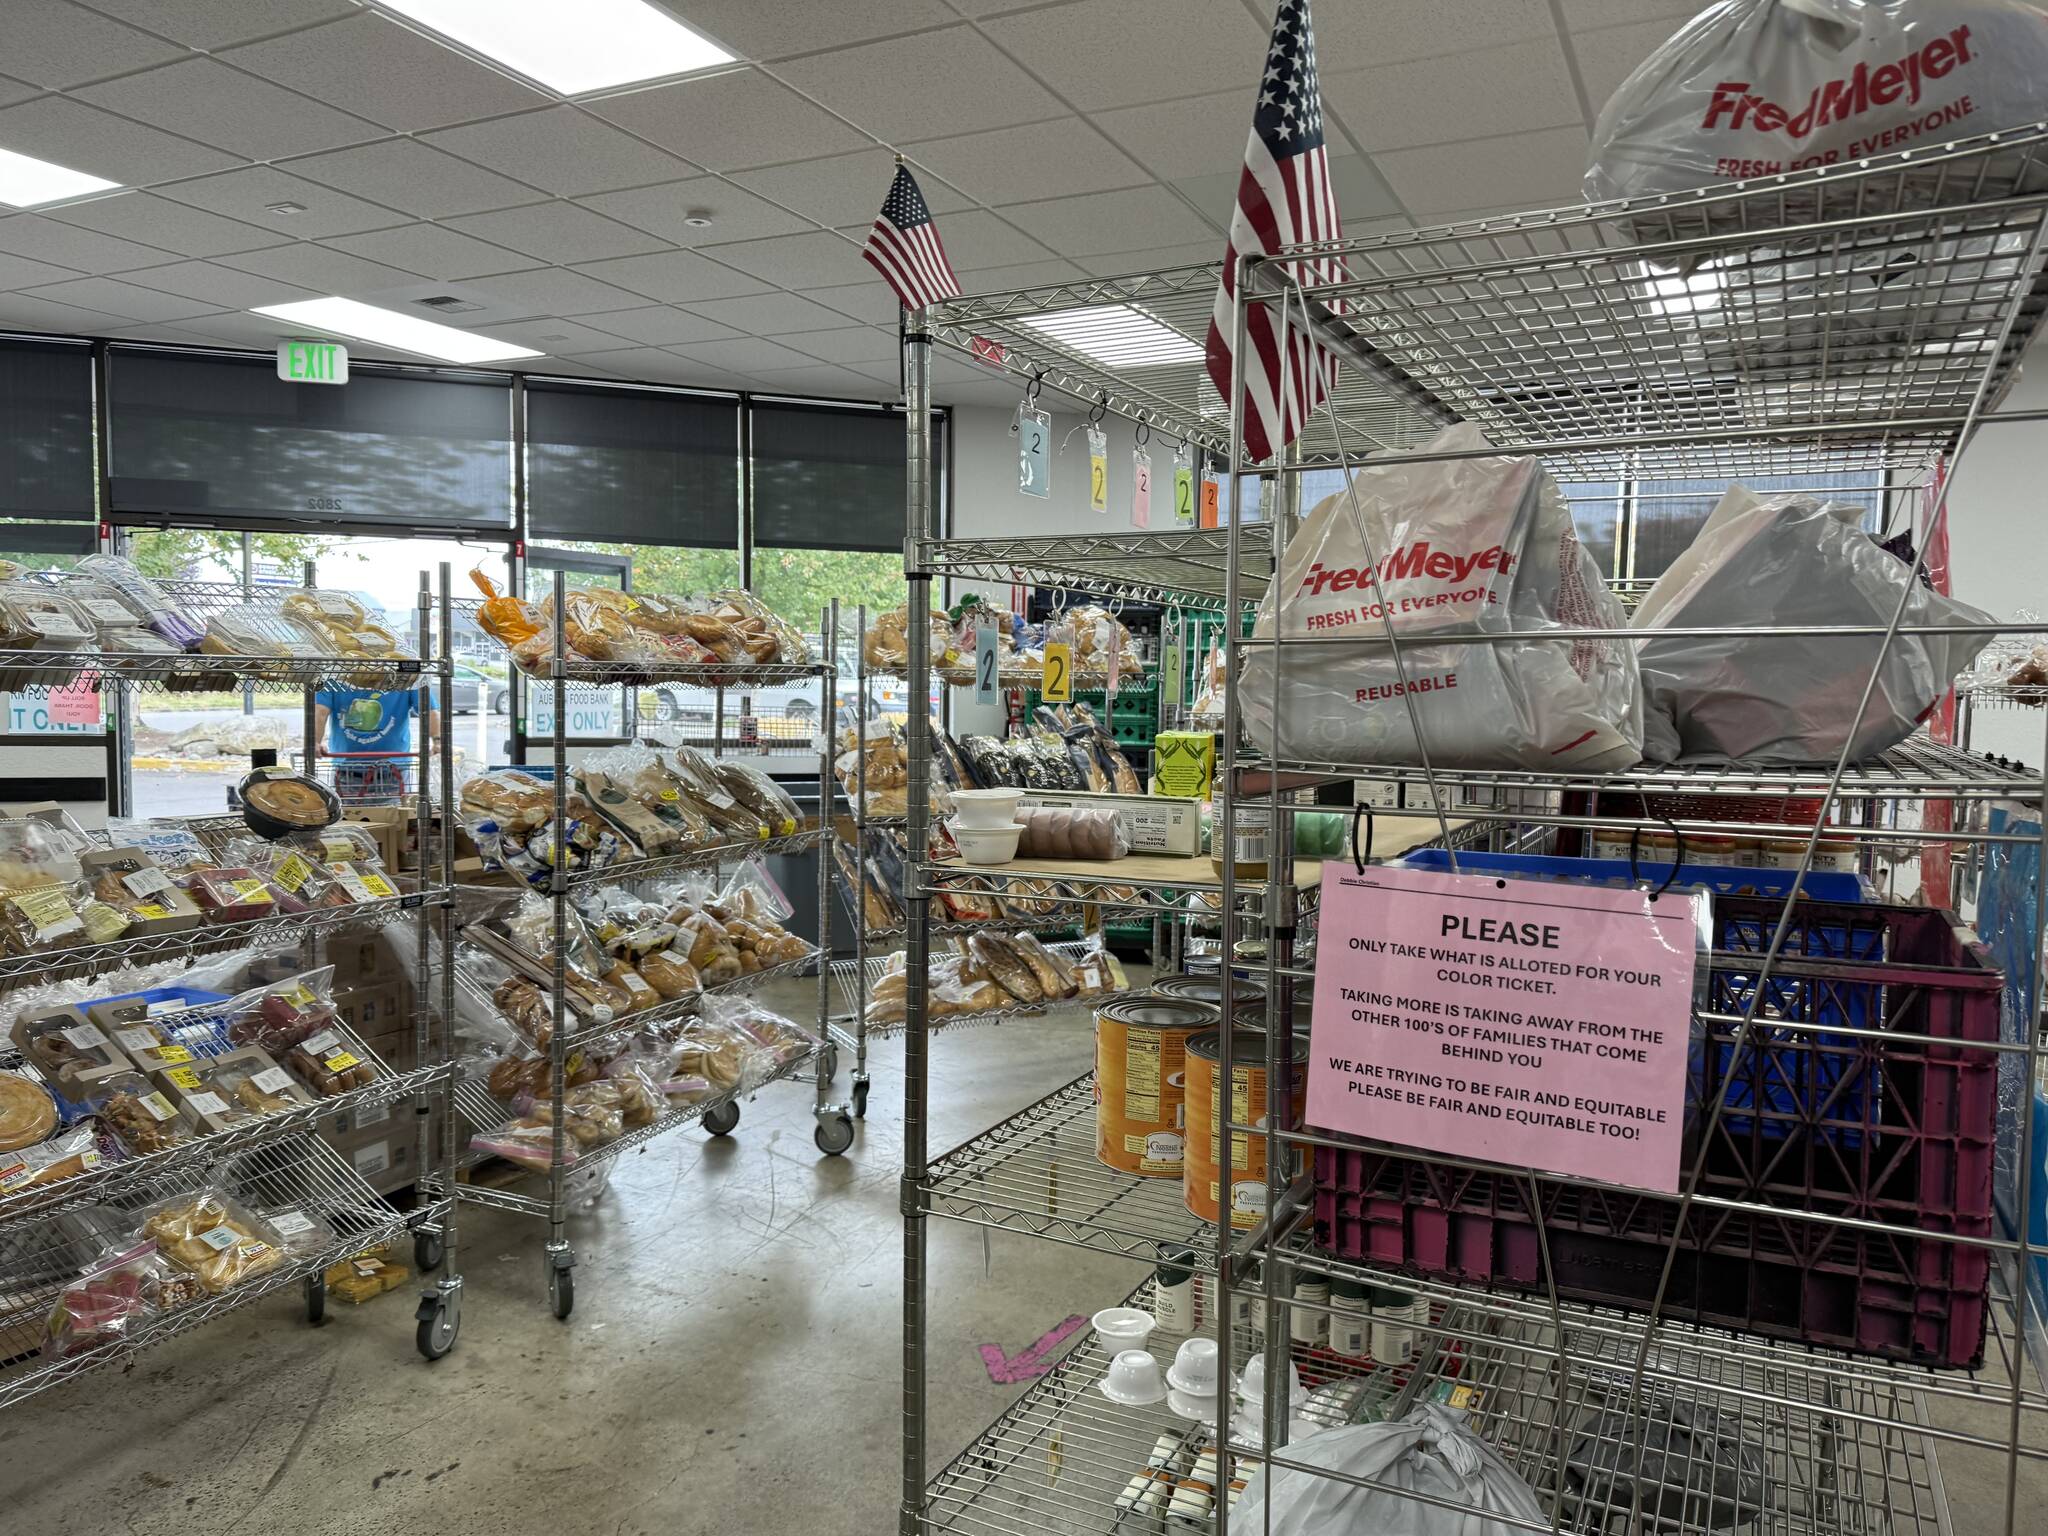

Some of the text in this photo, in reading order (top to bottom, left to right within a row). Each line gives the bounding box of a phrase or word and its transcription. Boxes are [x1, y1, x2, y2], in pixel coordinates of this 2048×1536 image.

[1714, 158, 1781, 178] FRESH
[1791, 150, 1839, 172] FOR
[289, 344, 336, 380] EXIT
[1031, 432, 1041, 455] 2
[1093, 466, 1104, 505] 2
[1140, 473, 1147, 493] 2
[1179, 479, 1191, 514] 2
[1208, 488, 1215, 506] 2
[1307, 608, 1357, 630] FRESH
[1361, 602, 1397, 621] FOR
[981, 649, 994, 691] 2
[1048, 655, 1064, 696] 2
[1171, 654, 1177, 671] 2
[570, 693, 589, 705] FOOD
[590, 693, 609, 705] BANK
[1356, 674, 1457, 702] REUSABLE
[573, 711, 610, 731] ONLY
[1441, 914, 1560, 949] PLEASE
[1349, 937, 1662, 987] ONLY TAKE WHAT IS ALLOTED FOR YOUR
[1437, 969, 1557, 995] COLOR TICKET.
[1340, 988, 1664, 1045] TAKING MORE IS TAKING AWAY FROM THE
[1351, 1009, 1400, 1028] OTHER
[1448, 1024, 1470, 1038] OF
[1473, 1028, 1547, 1049] FAMILIES
[1550, 1037, 1593, 1055] THAT
[1596, 1044, 1648, 1063] COME
[1441, 1043, 1543, 1068] BEHIND YOU
[1329, 1057, 1667, 1124] WE ARE TRYING TO BE FAIR AND EQUITABLE
[1348, 1081, 1640, 1141] PLEASE BE FAIR AND EQUITABLE TOO!
